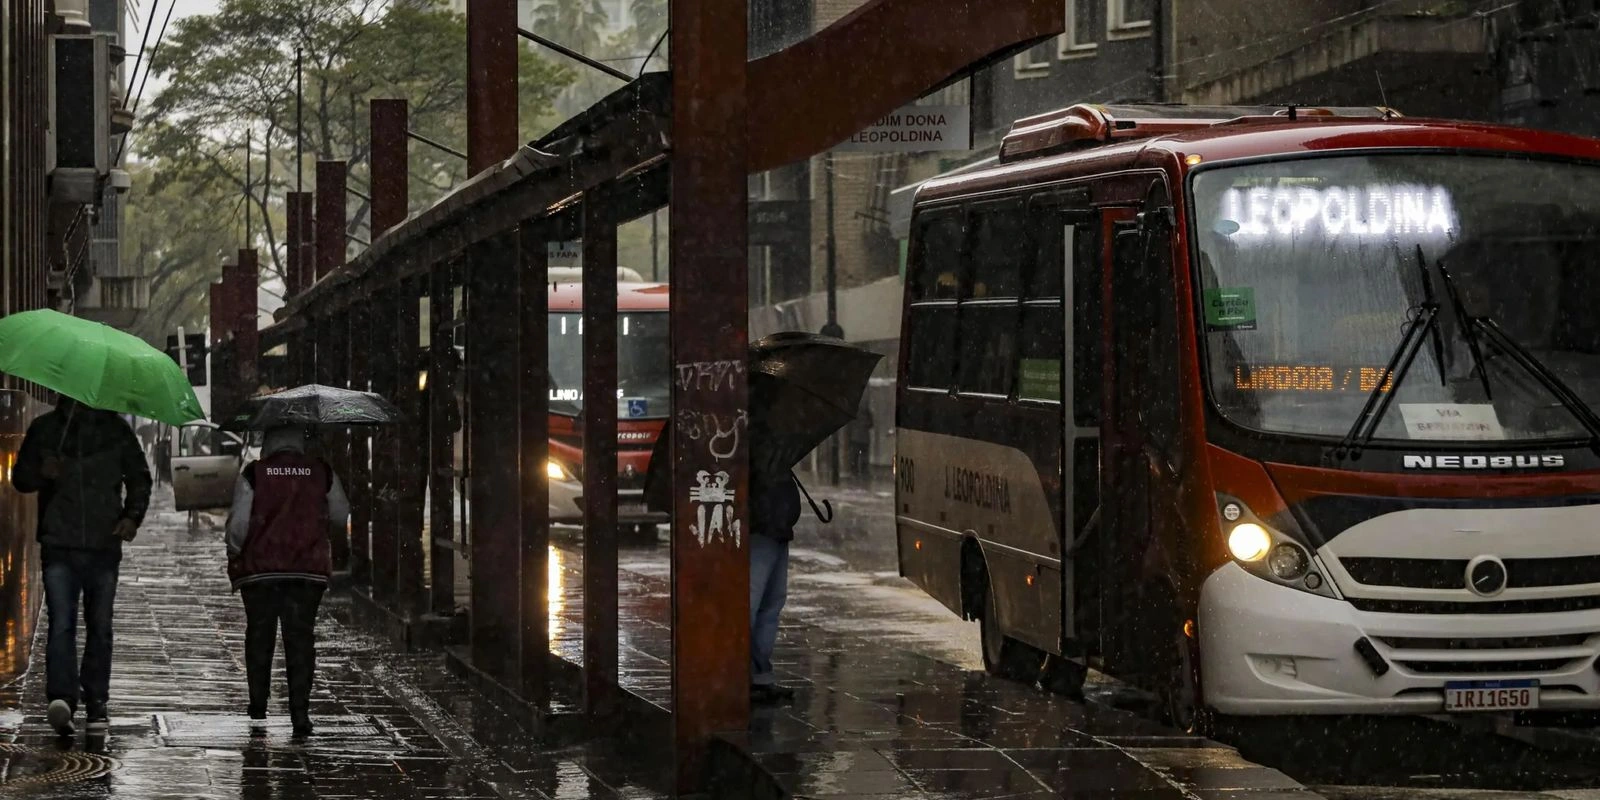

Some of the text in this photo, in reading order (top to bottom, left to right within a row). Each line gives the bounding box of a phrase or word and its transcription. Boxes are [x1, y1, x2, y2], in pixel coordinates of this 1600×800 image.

[873, 114, 947, 127] DIM DONA
[851, 130, 943, 143] LEOPOLDINA
[1228, 189, 1452, 234] LEOPOLDINA
[1403, 454, 1565, 469] NEOBUS
[266, 467, 311, 476] ROLHANO
[953, 466, 1012, 514] LEOPOLDINA
[1454, 689, 1530, 708] IRI1G50
